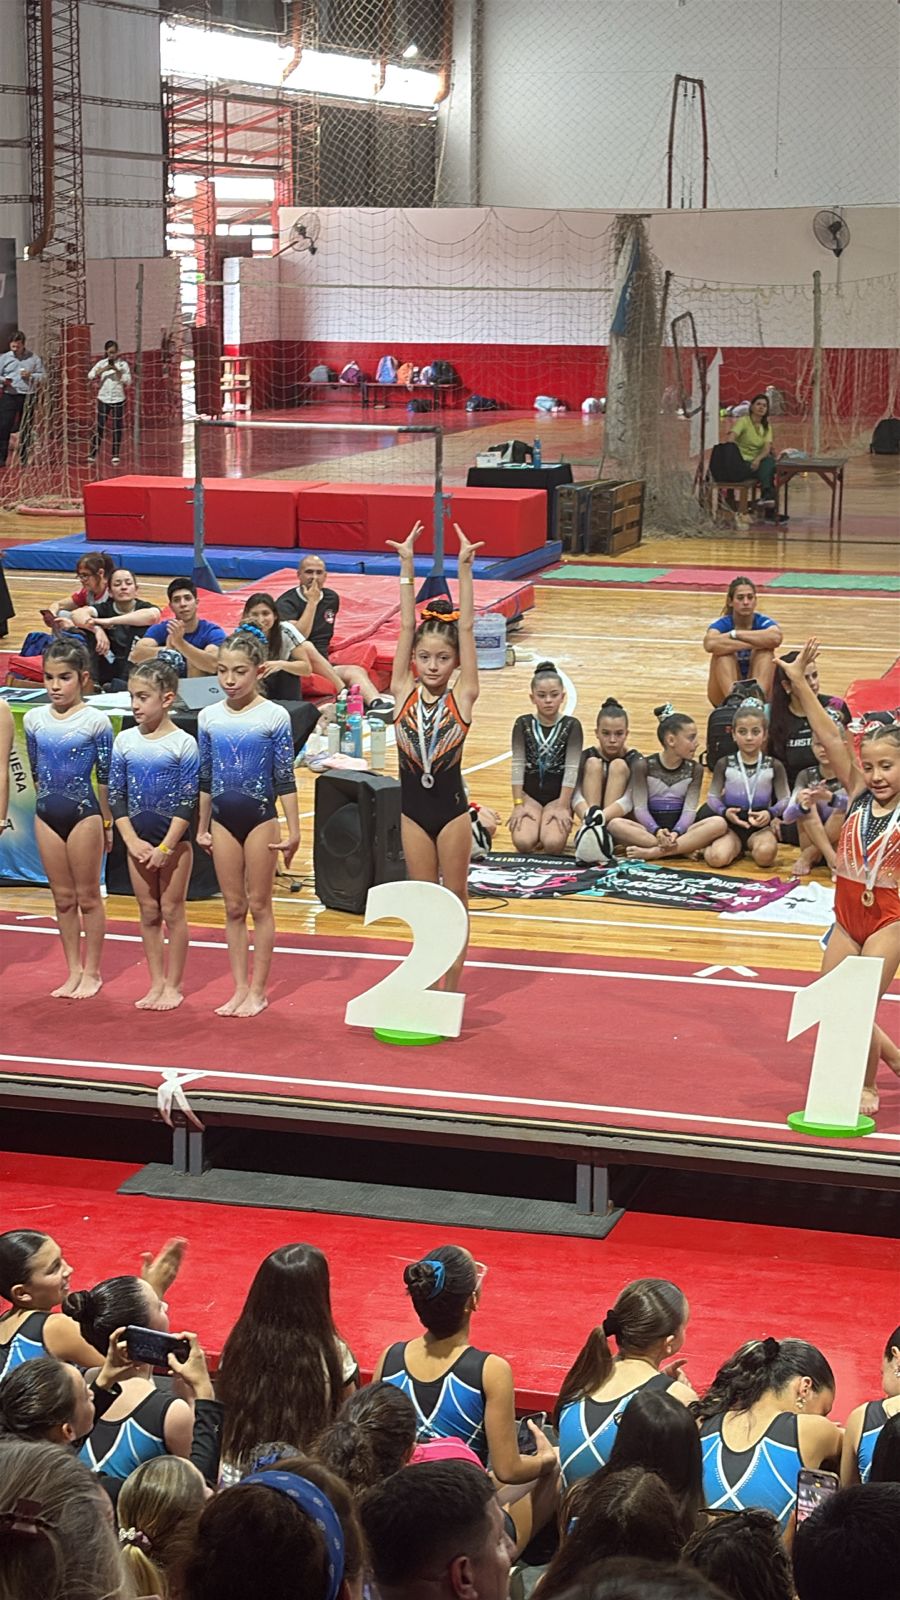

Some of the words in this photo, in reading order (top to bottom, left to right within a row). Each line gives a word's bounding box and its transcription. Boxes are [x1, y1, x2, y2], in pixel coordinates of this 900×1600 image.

[786, 738, 812, 747] LAST
[345, 880, 469, 1037] 2
[787, 955, 884, 1127] 1
